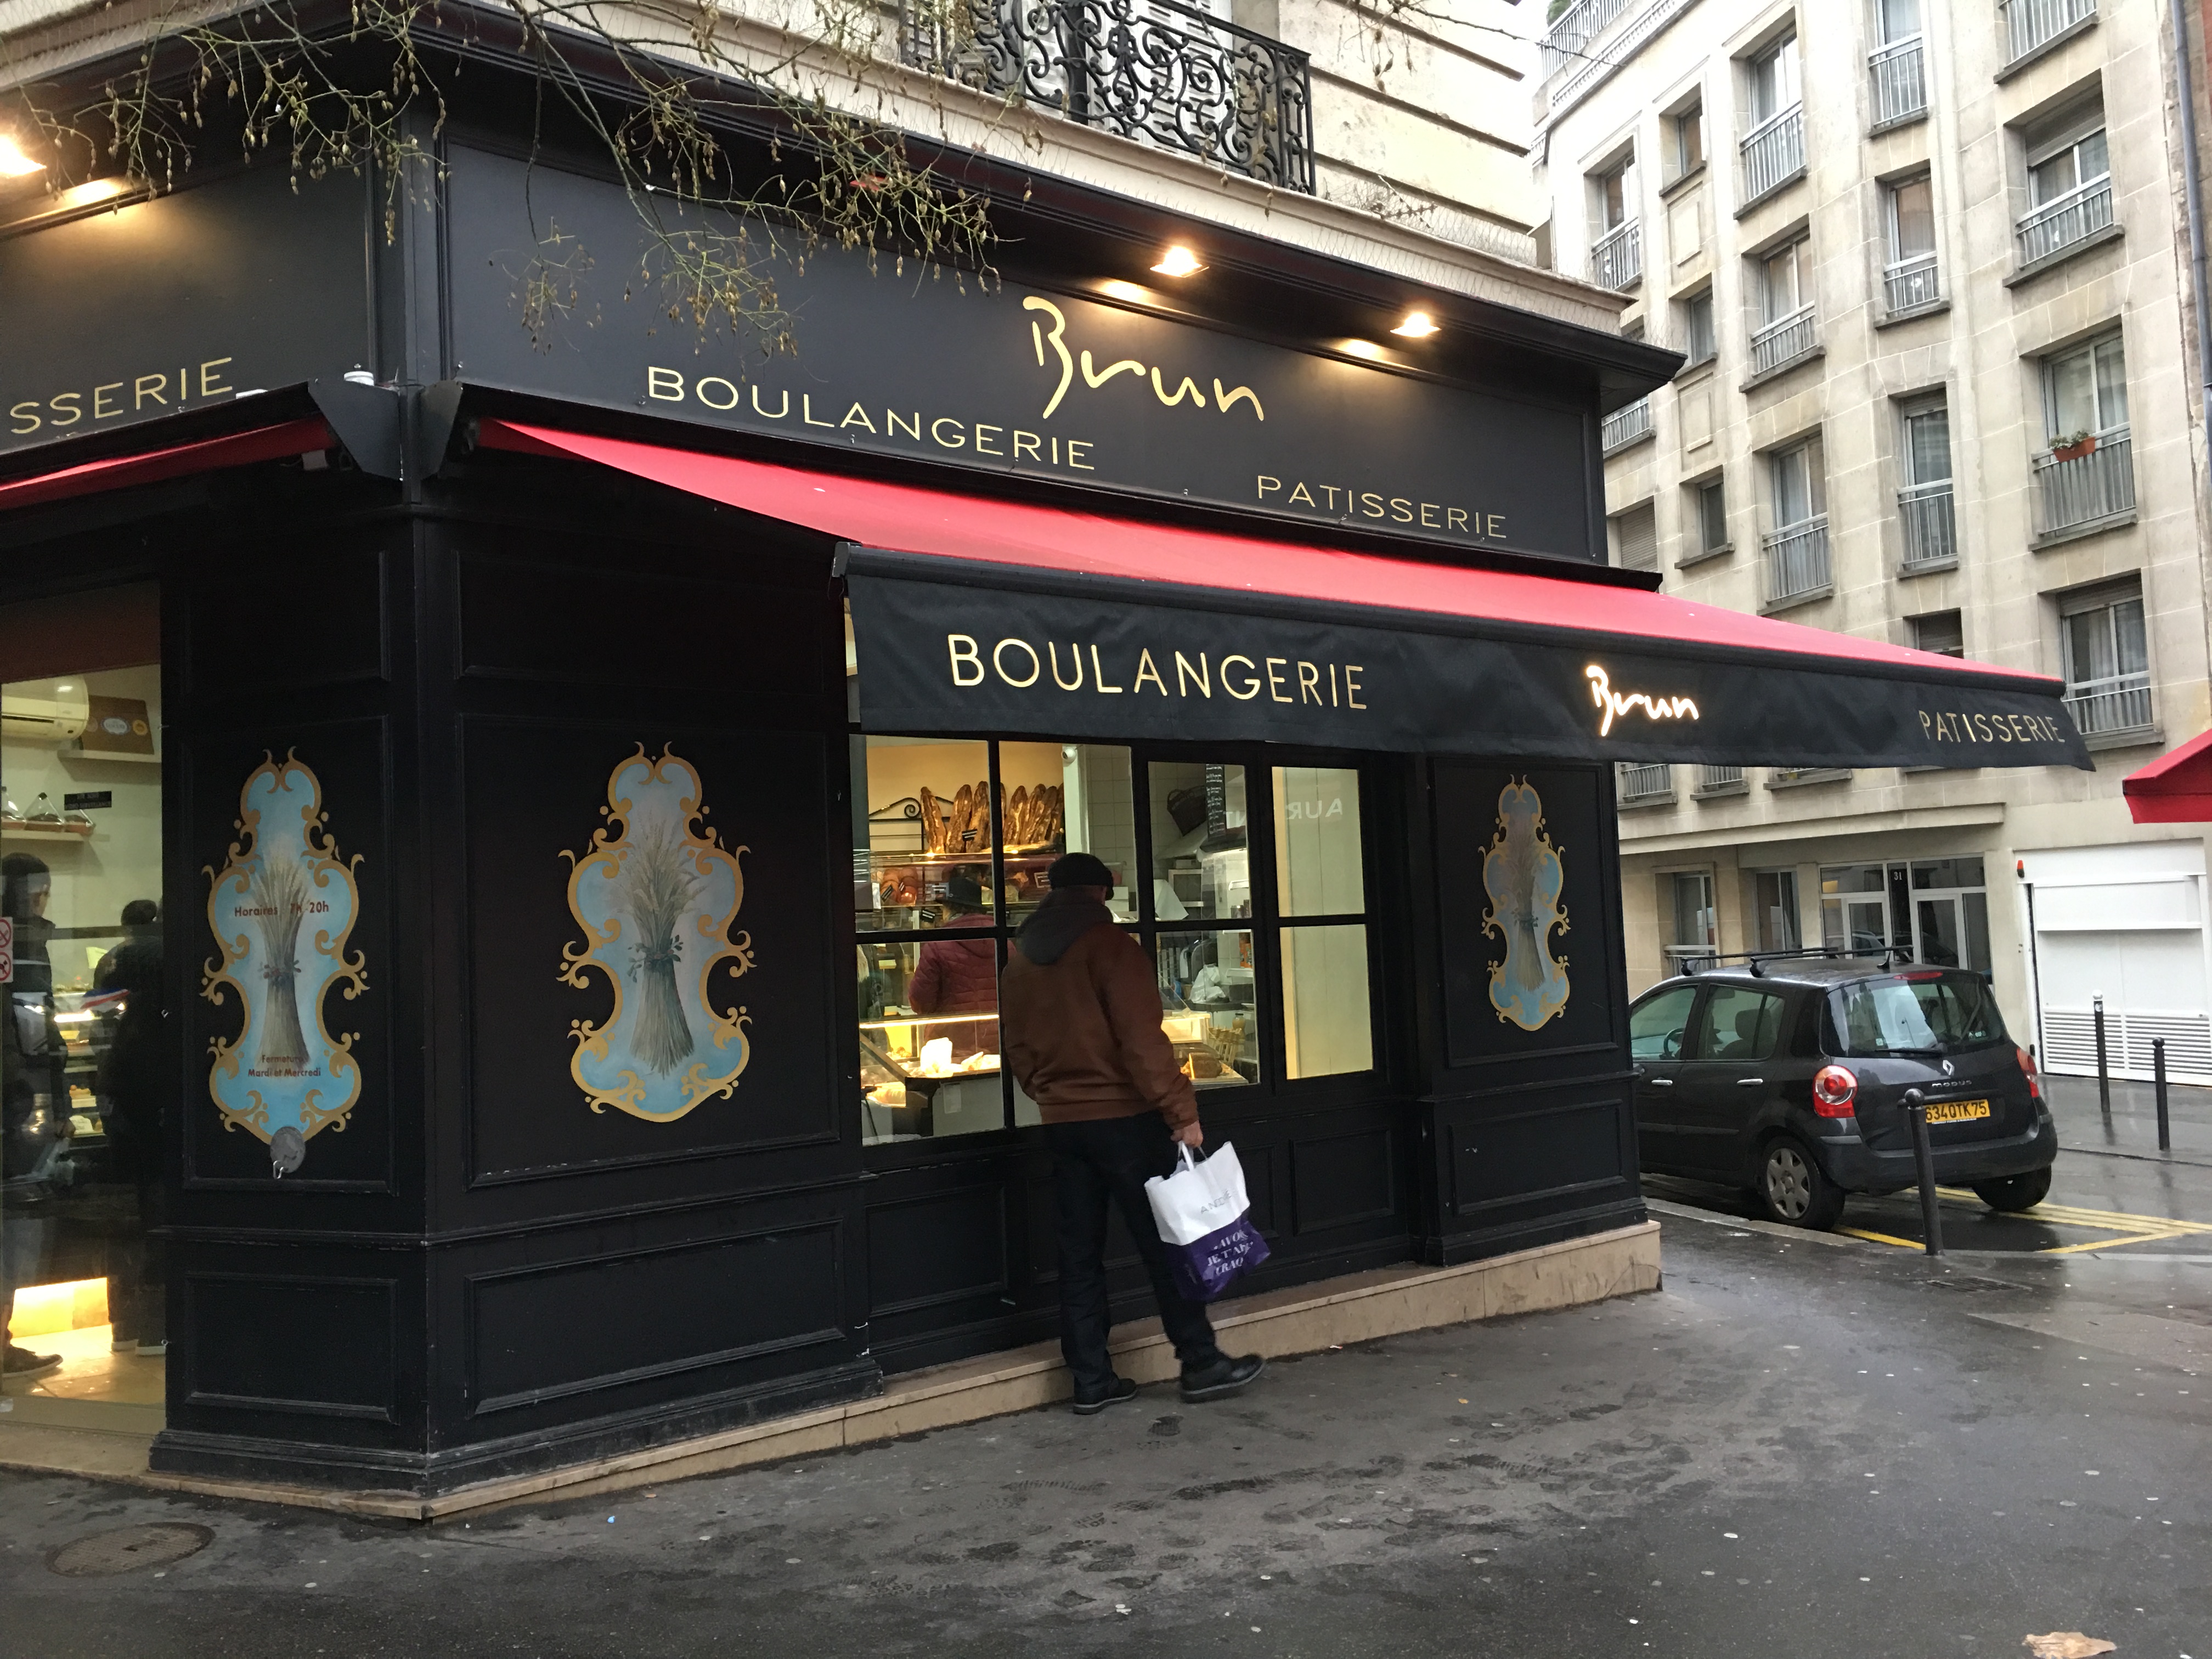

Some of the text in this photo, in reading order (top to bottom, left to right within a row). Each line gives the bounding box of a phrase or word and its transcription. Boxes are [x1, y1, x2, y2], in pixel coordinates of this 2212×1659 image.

[1023, 296, 1263, 421] Brun
[10, 357, 233, 433] SSERIE
[648, 366, 1094, 470] BOULANGERIE
[1257, 475, 1506, 538] PATISSERIE
[947, 634, 1367, 709] BOULANGERIE
[1586, 665, 1699, 736] Brun
[1918, 710, 2065, 742] PATISSERIE
[1894, 871, 1903, 881] 31
[235, 905, 278, 917] Horaires
[309, 901, 329, 913] 20h
[248, 1068, 272, 1077] Mardi
[284, 1067, 321, 1076] Mercredi
[262, 1054, 304, 1063] Fermeture
